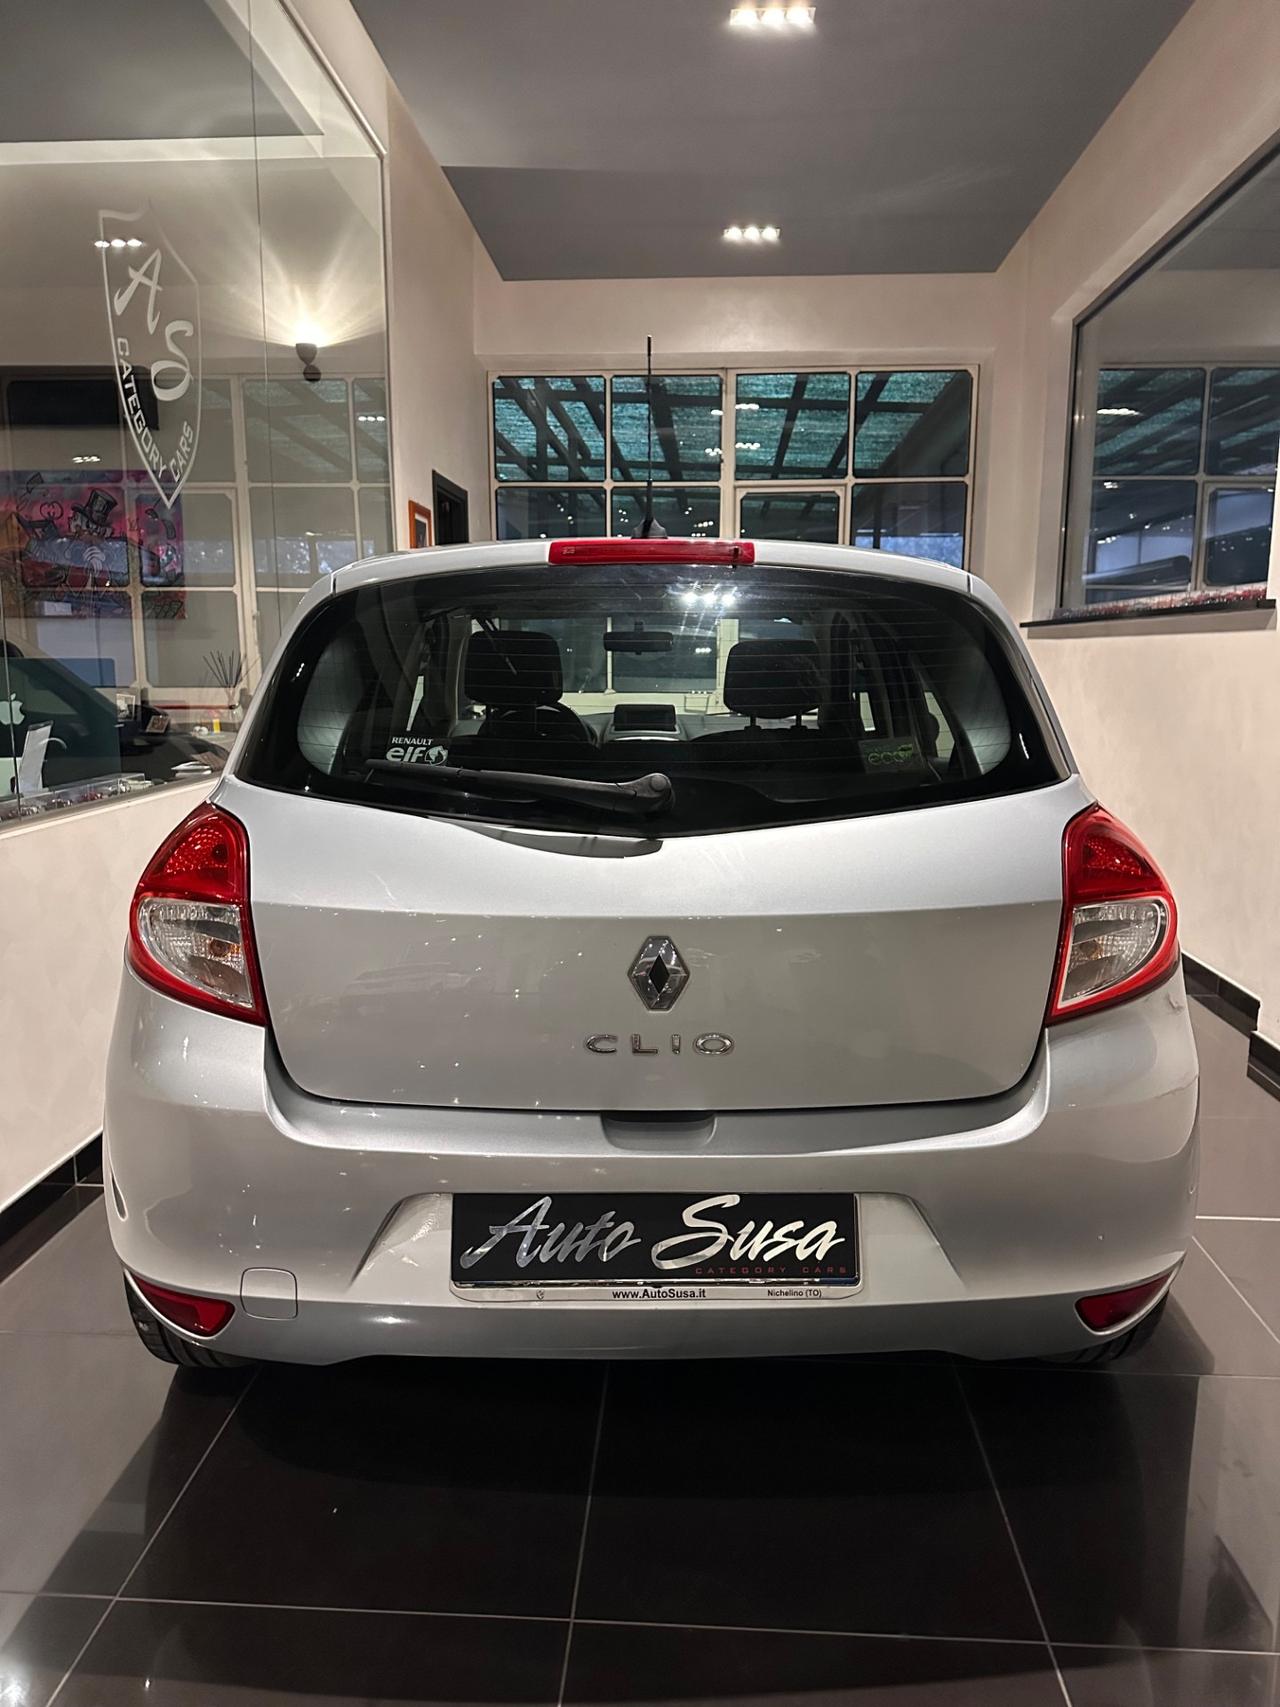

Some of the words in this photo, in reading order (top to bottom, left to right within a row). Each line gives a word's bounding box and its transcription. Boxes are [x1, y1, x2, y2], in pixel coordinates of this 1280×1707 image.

[116, 337, 167, 479] CATEGORY
[169, 420, 194, 483] CARS
[392, 736, 433, 746] RENAULT
[386, 746, 426, 762] elf
[584, 1033, 735, 1055] CLIO
[459, 1195, 642, 1270] Auto
[651, 1193, 846, 1271] Susa
[695, 1266, 787, 1275] CATEGORY
[801, 1266, 848, 1274] CARS
[611, 1287, 707, 1299] www.AutoSusa.it
[767, 1288, 804, 1297] Nichelino
[804, 1289, 822, 1298] (TO)
